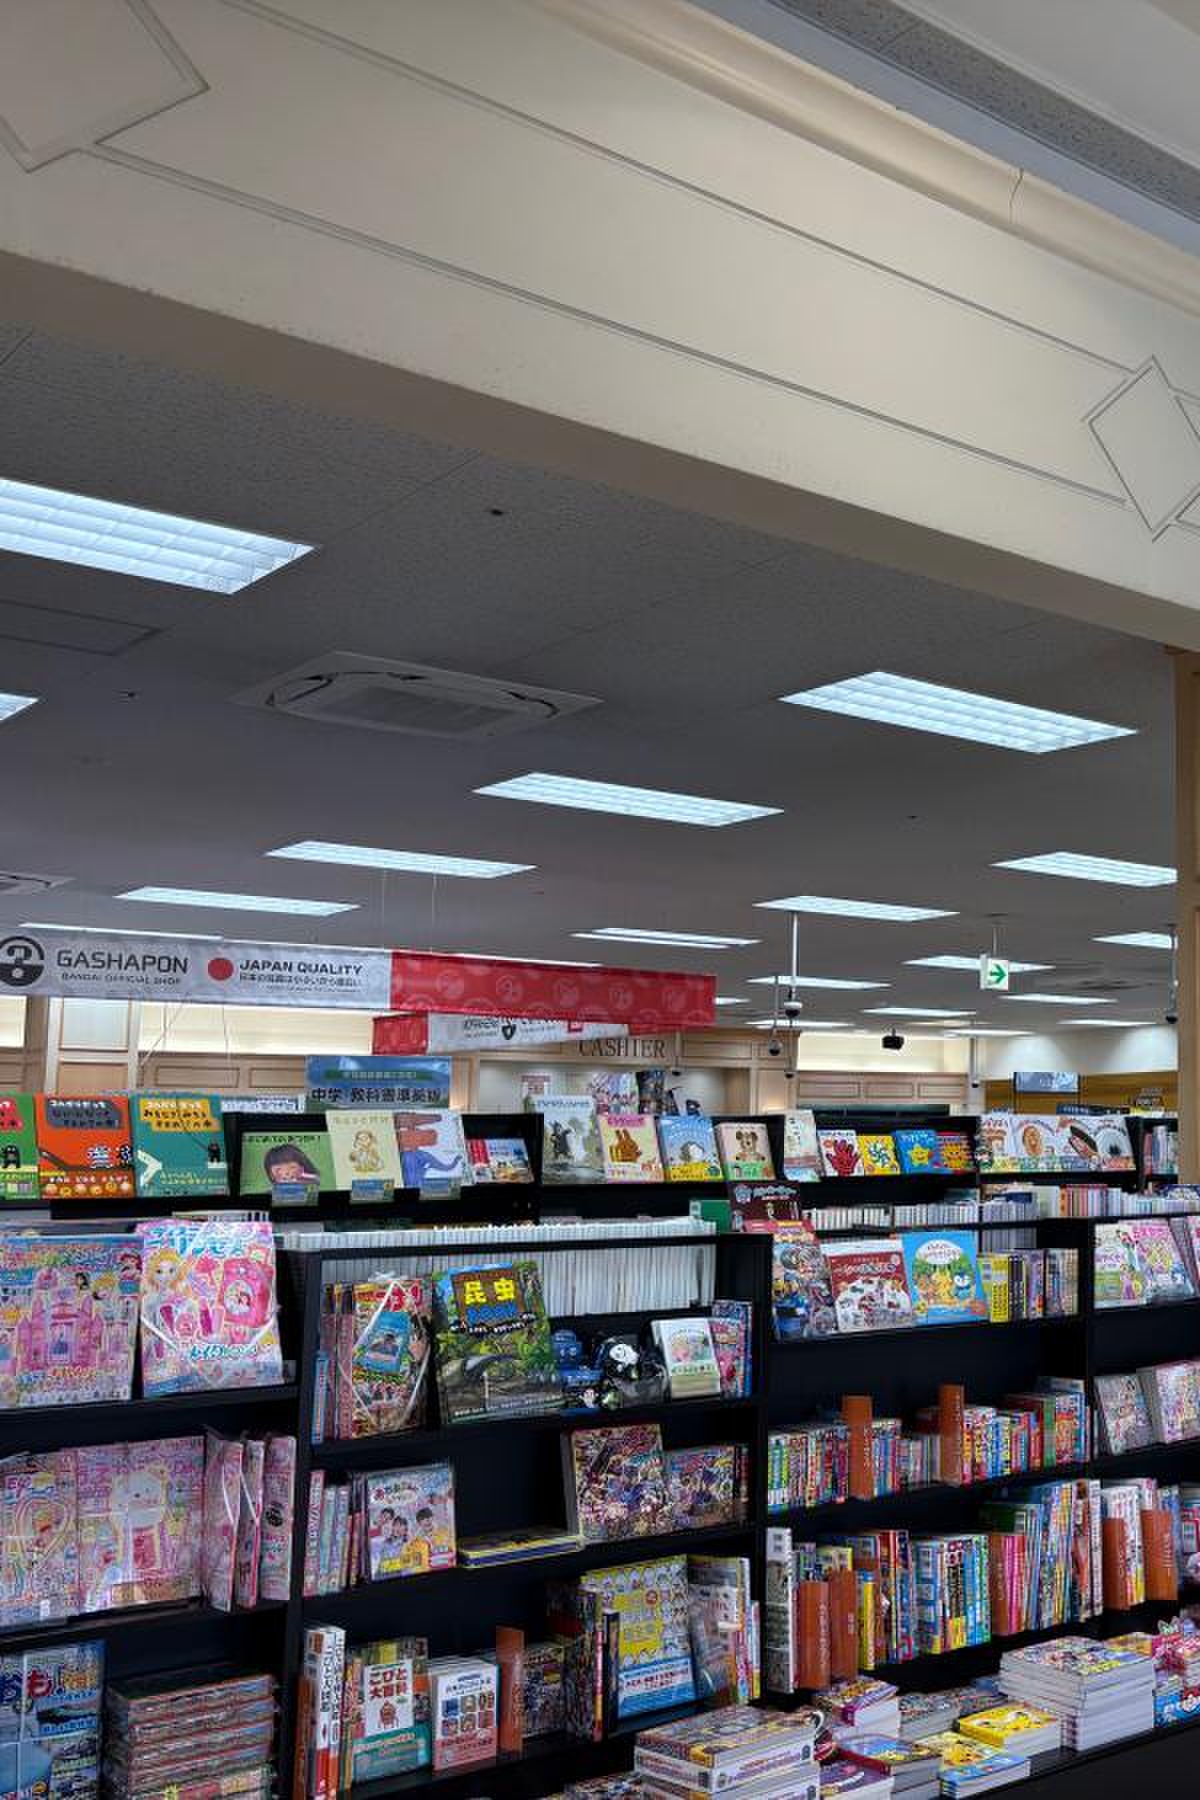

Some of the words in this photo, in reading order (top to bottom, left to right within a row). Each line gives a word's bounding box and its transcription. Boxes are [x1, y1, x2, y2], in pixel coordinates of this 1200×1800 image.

[57, 949, 189, 974] GASHAPON
[240, 960, 294, 972] JAPAN
[297, 961, 363, 975] QUALITY
[578, 1038, 666, 1058] CASHIER
[464, 1278, 516, 1305] 昆虫
